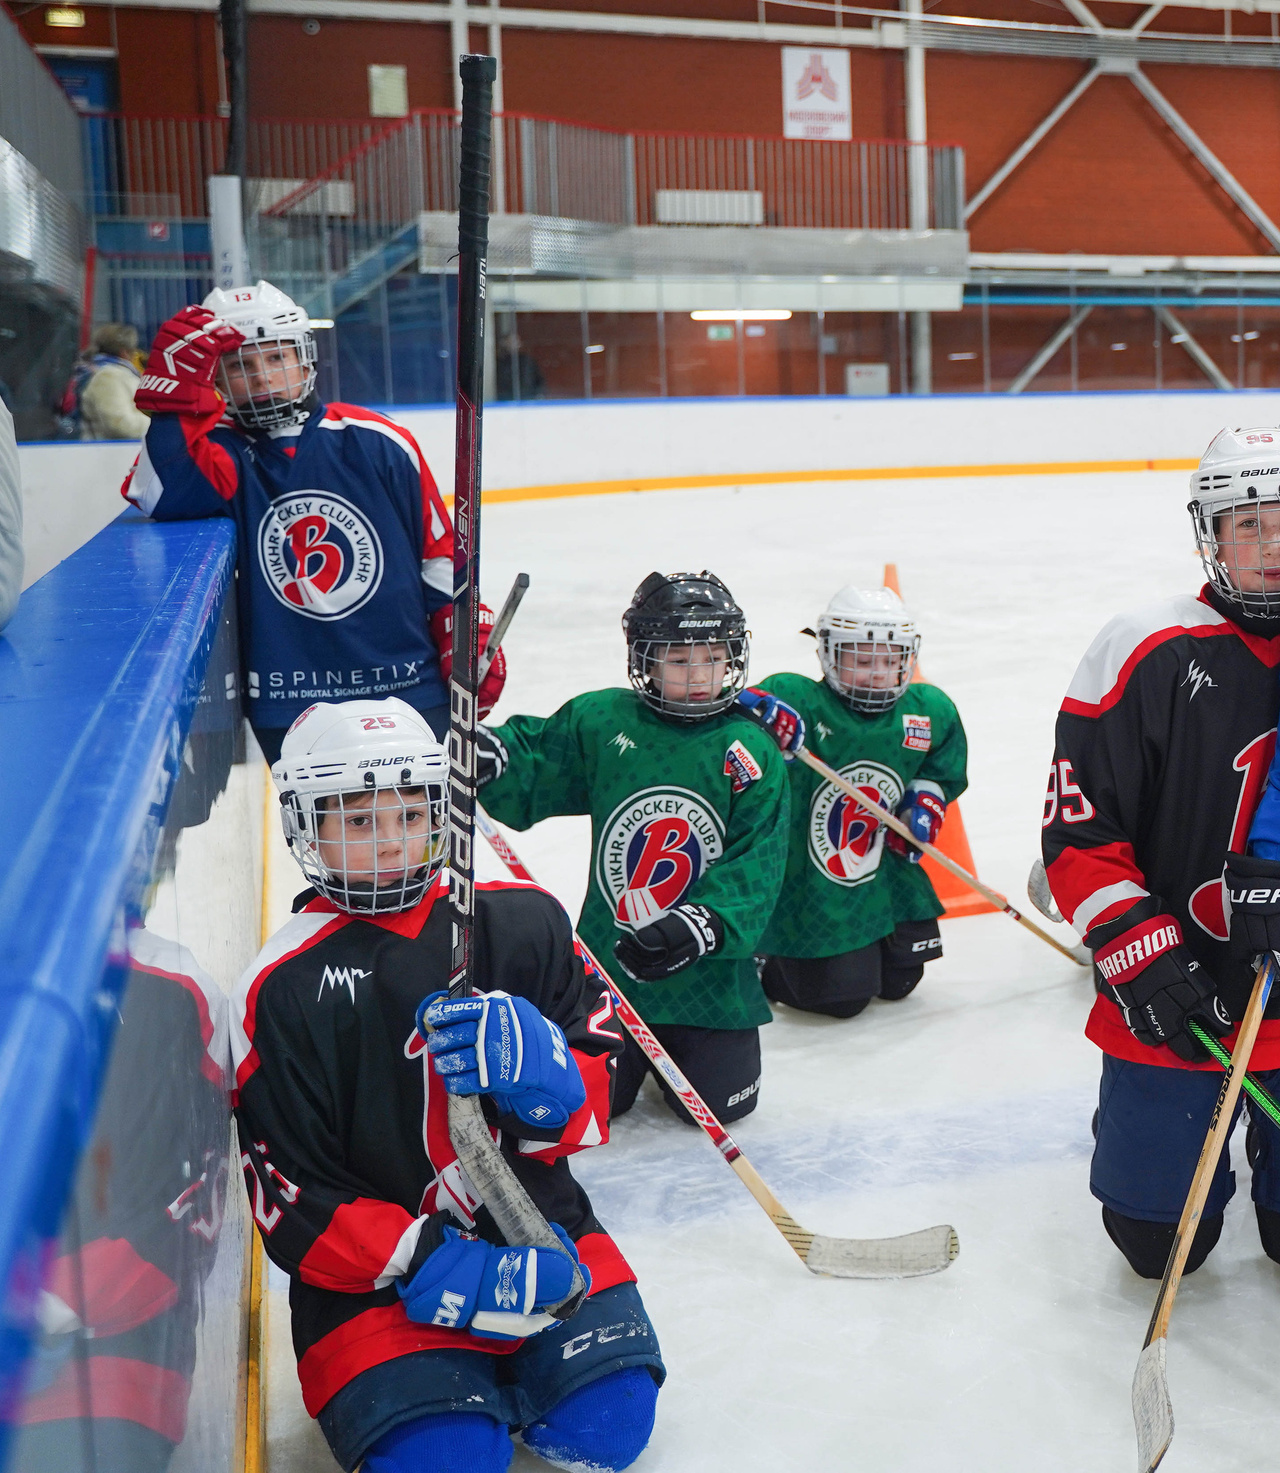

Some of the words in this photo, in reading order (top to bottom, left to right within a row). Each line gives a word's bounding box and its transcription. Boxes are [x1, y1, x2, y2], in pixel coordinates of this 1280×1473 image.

[478, 257, 487, 300] UER
[235, 293, 251, 303] 13
[1246, 433, 1273, 444] 95
[277, 502, 312, 524] CKEY
[319, 503, 356, 530] CLUB
[268, 534, 285, 583] VIKHR
[355, 537, 371, 583] VIKHR
[678, 619, 722, 629] BAUER
[269, 661, 419, 687] SPINETIX
[288, 690, 299, 698] IN
[300, 689, 333, 698] DIGITAL
[334, 686, 372, 697] SIGNAGE
[373, 677, 421, 694] SOLUTIONS
[360, 716, 396, 731] 25
[357, 755, 416, 769] BAUER
[735, 747, 758, 777] РОССИЯ
[449, 678, 479, 916] BAUER
[1042, 758, 1096, 829] 95
[621, 800, 684, 832] HOCKEY
[687, 809, 716, 846] CLUB
[814, 811, 829, 857] VIKHR
[610, 840, 625, 895] VIKHR
[679, 904, 717, 951] EAST
[1096, 925, 1180, 980] WARRIOR
[443, 1002, 483, 1013] ЭФСИ
[1146, 1004, 1165, 1038] ALPHA
[727, 1078, 760, 1107] BAU
[1209, 1064, 1235, 1132] OROKS
